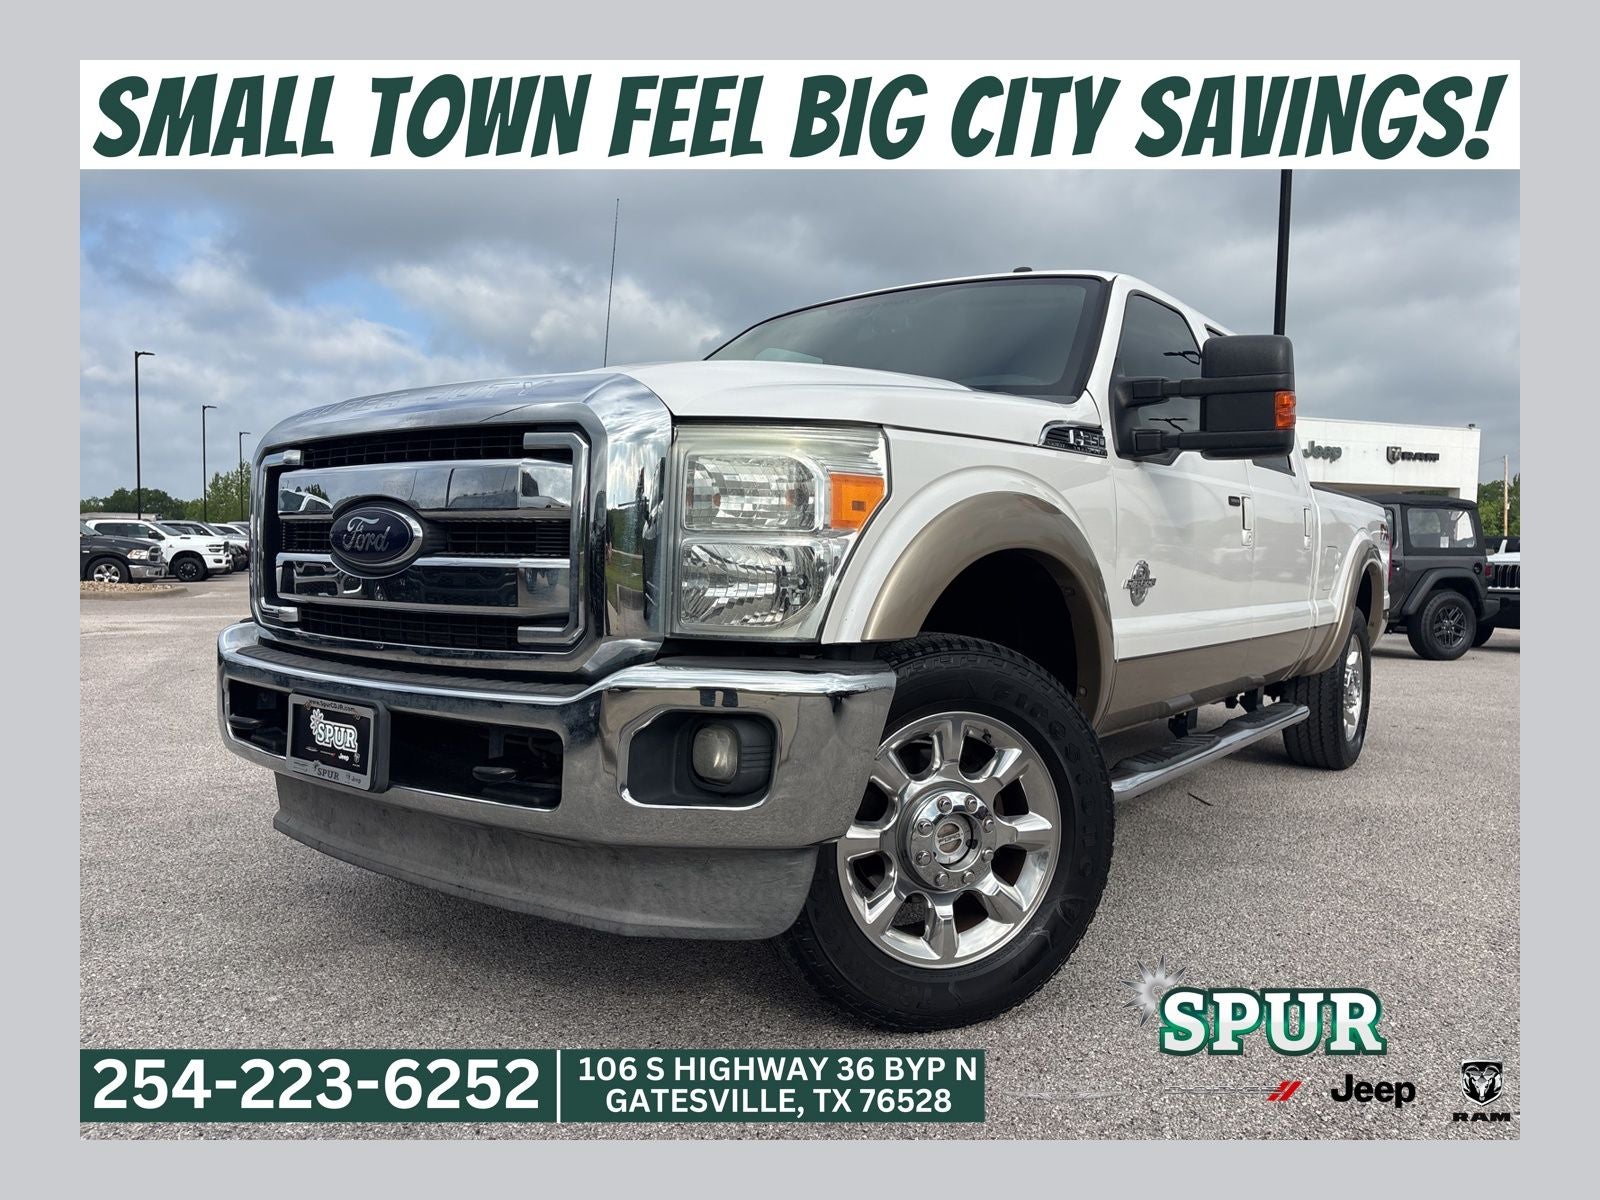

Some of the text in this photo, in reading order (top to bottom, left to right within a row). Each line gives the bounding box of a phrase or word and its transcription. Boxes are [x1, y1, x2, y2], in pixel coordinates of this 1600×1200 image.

[1302, 440, 1342, 463] Jeep
[342, 516, 391, 552] Ford
[316, 722, 357, 749] SPUR
[317, 766, 340, 781] SPUR
